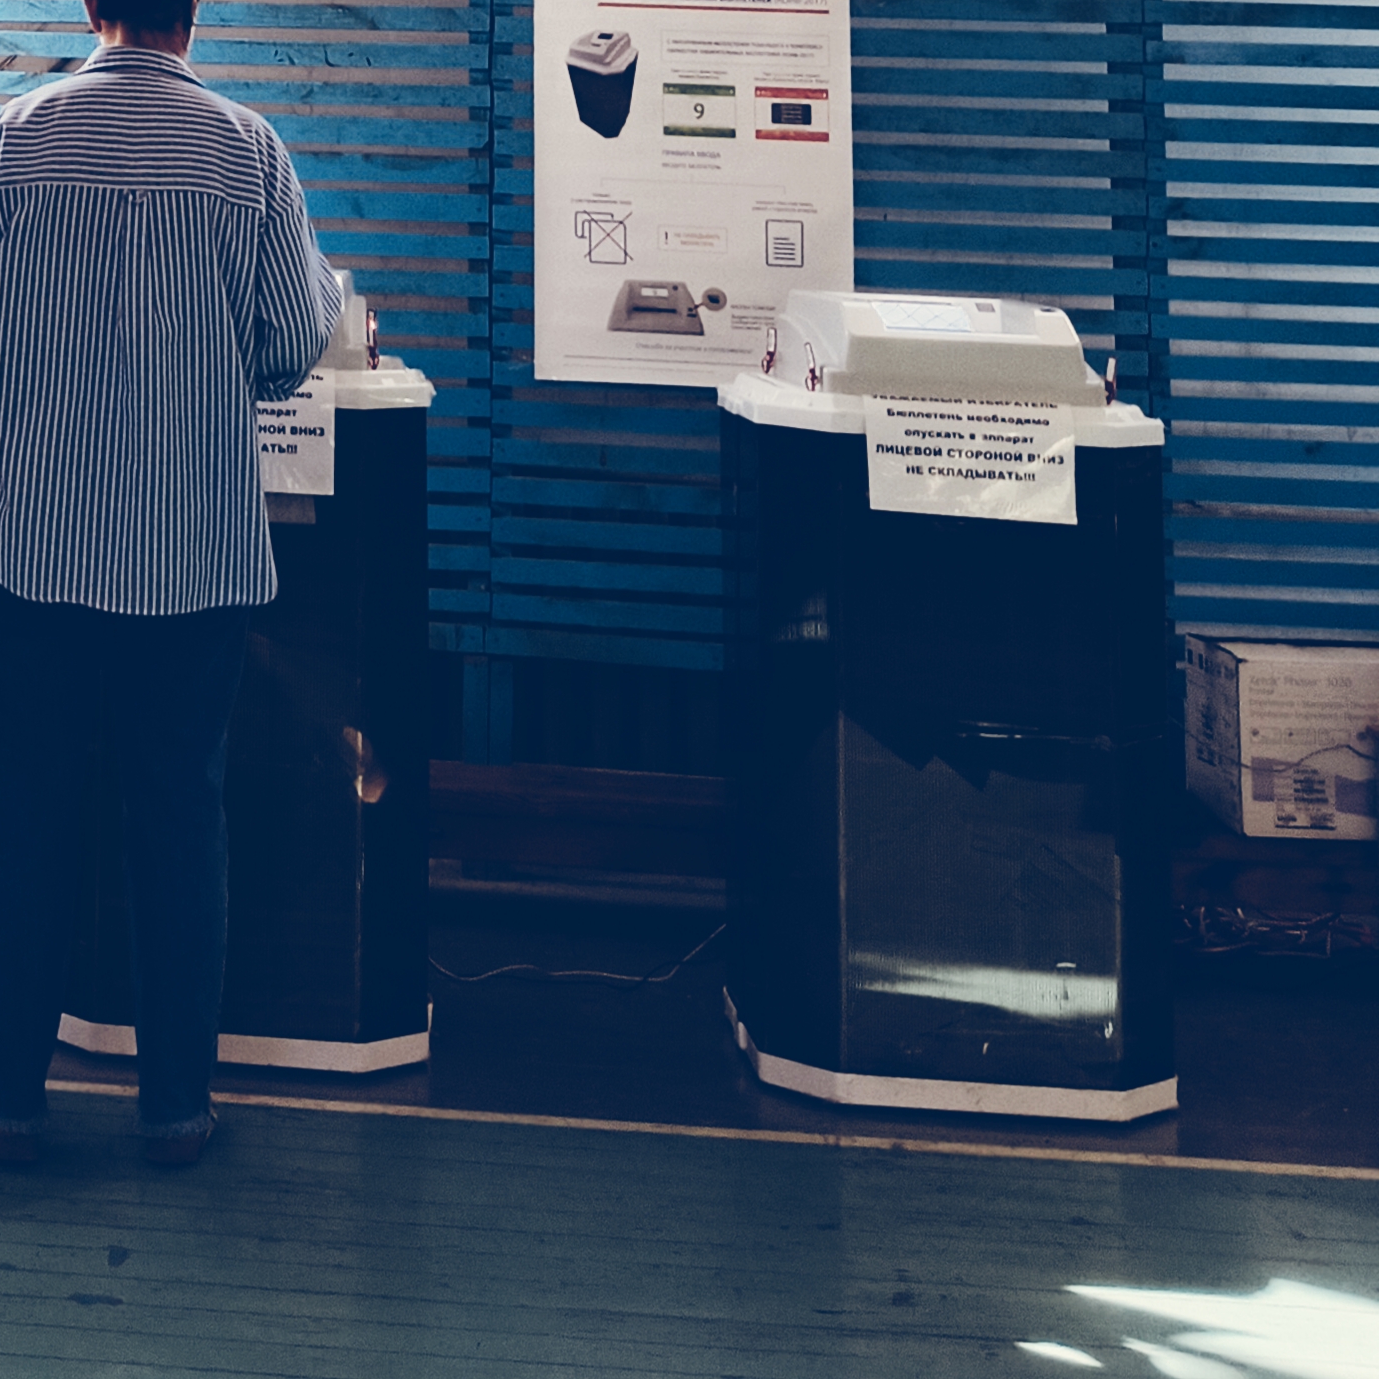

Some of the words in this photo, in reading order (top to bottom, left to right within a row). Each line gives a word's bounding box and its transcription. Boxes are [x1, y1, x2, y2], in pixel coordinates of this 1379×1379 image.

[693, 102, 705, 119] 9
[289, 425, 325, 437] ВНИЗ
[875, 443, 943, 457] ЛИЦЕВОЙ
[947, 447, 1023, 462] СТОРОНОЙ
[905, 464, 924, 475] НЕ
[928, 465, 1036, 482] СКЛАДЫВАТЬ!!!
